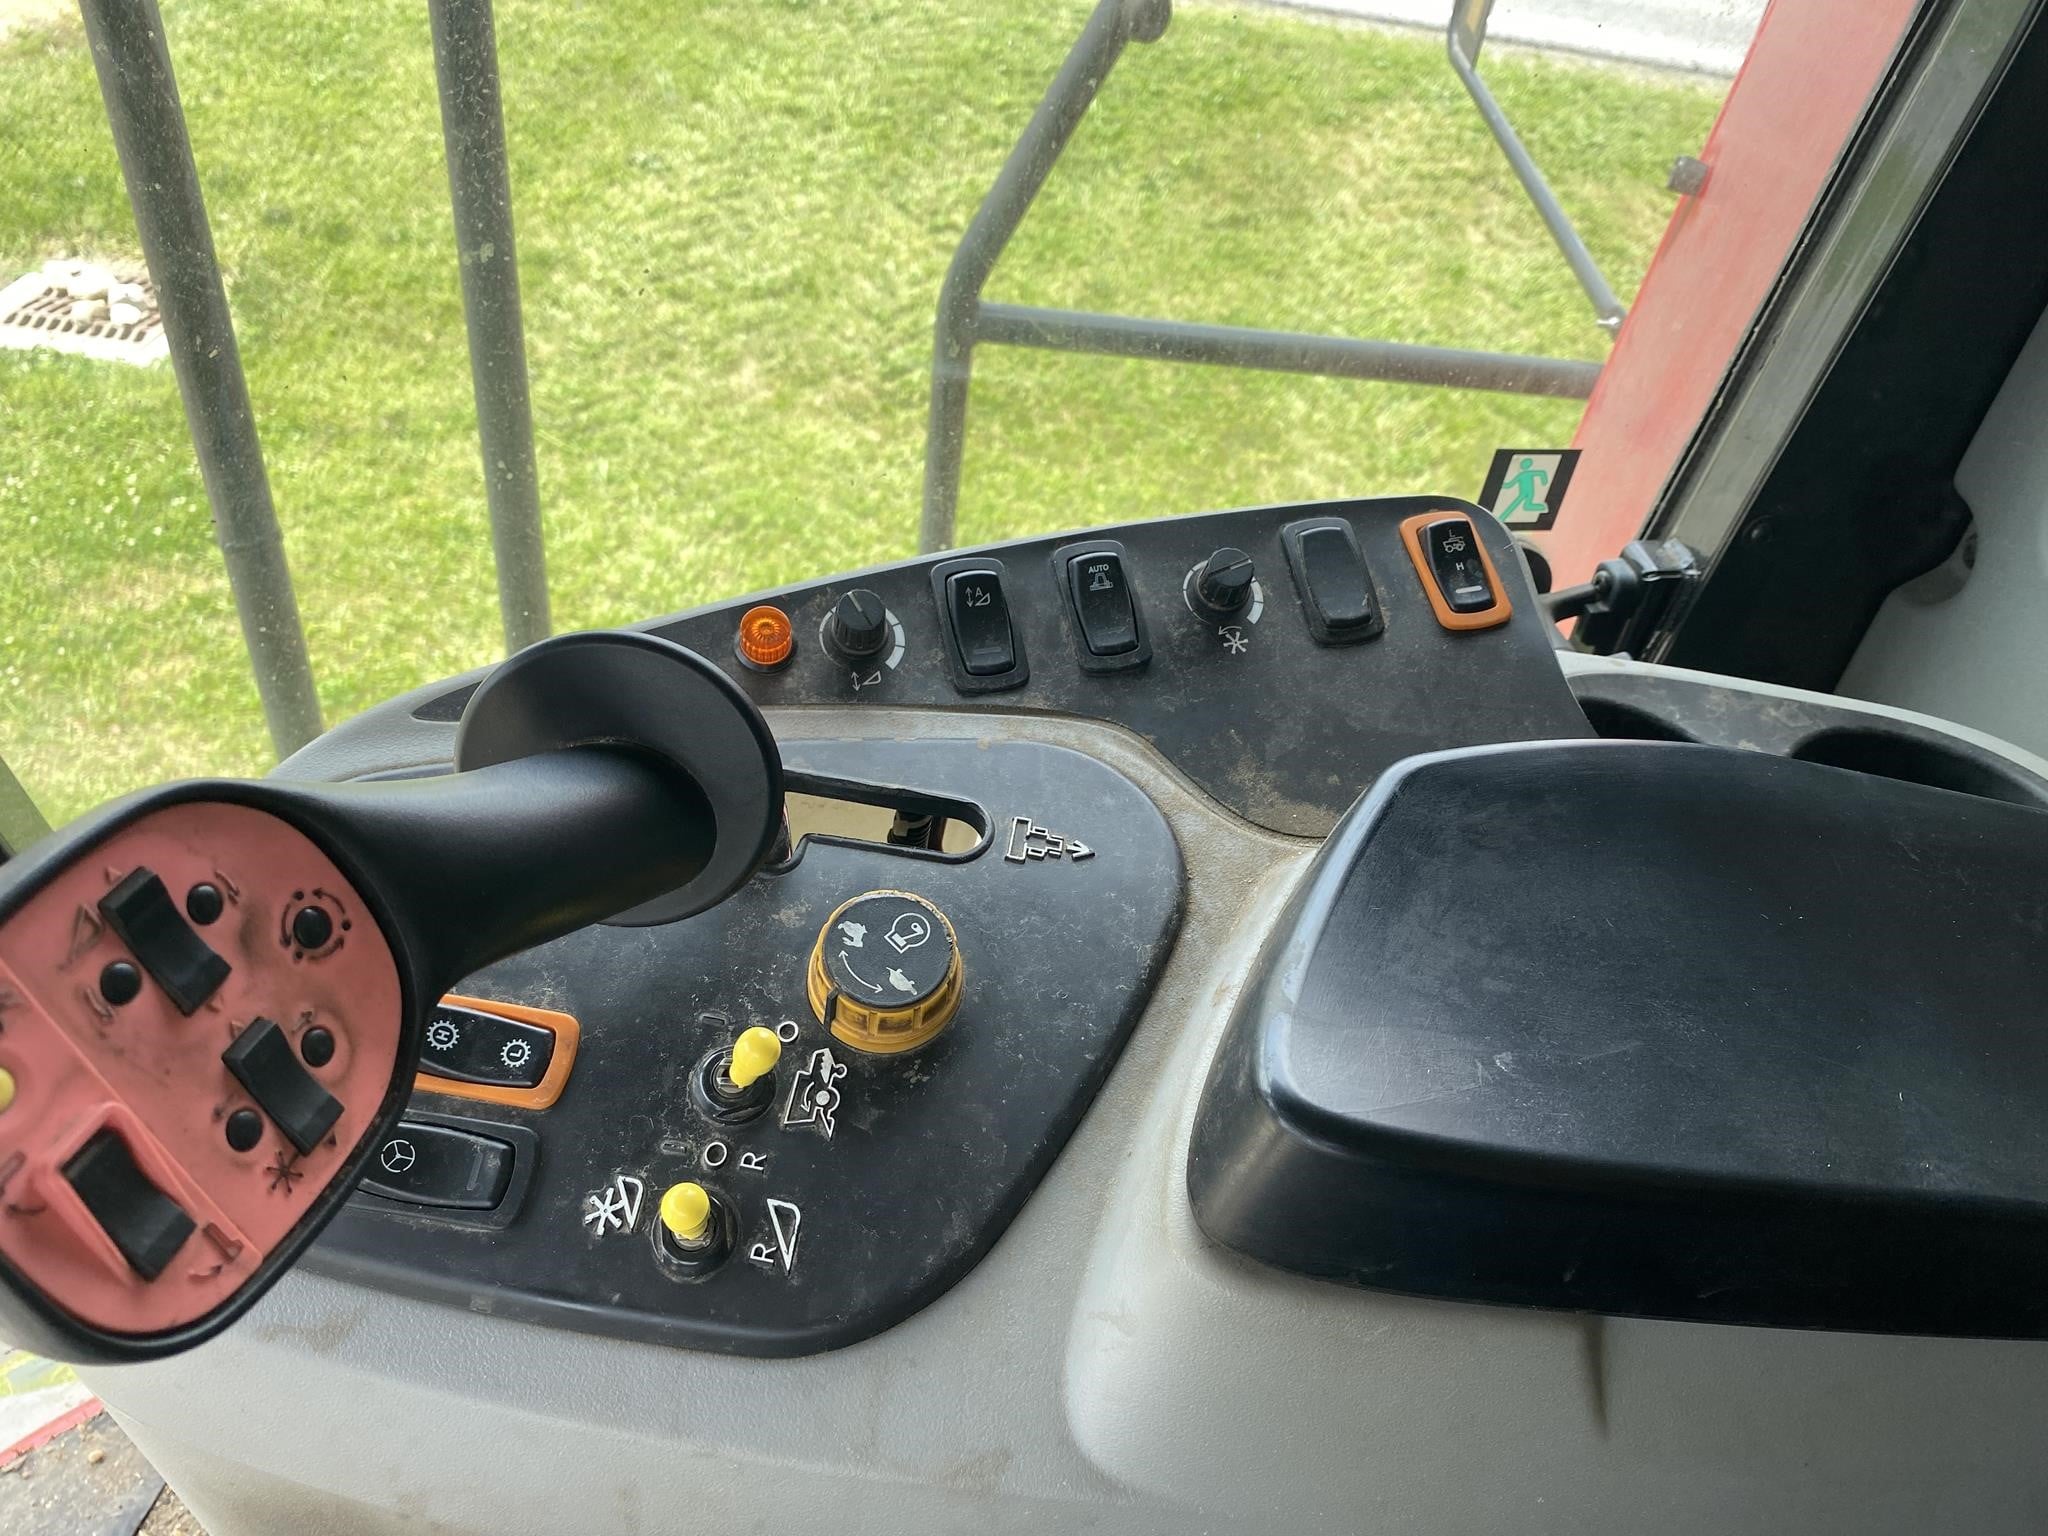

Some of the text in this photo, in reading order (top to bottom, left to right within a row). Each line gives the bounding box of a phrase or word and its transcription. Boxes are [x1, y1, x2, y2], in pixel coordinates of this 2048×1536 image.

[1088, 564, 1110, 574] AUTO
[1455, 562, 1465, 571] H
[975, 586, 983, 597] A
[436, 1029, 450, 1041] H
[509, 1048, 522, 1058] L
[740, 1152, 767, 1171] R
[750, 1243, 777, 1263] R
